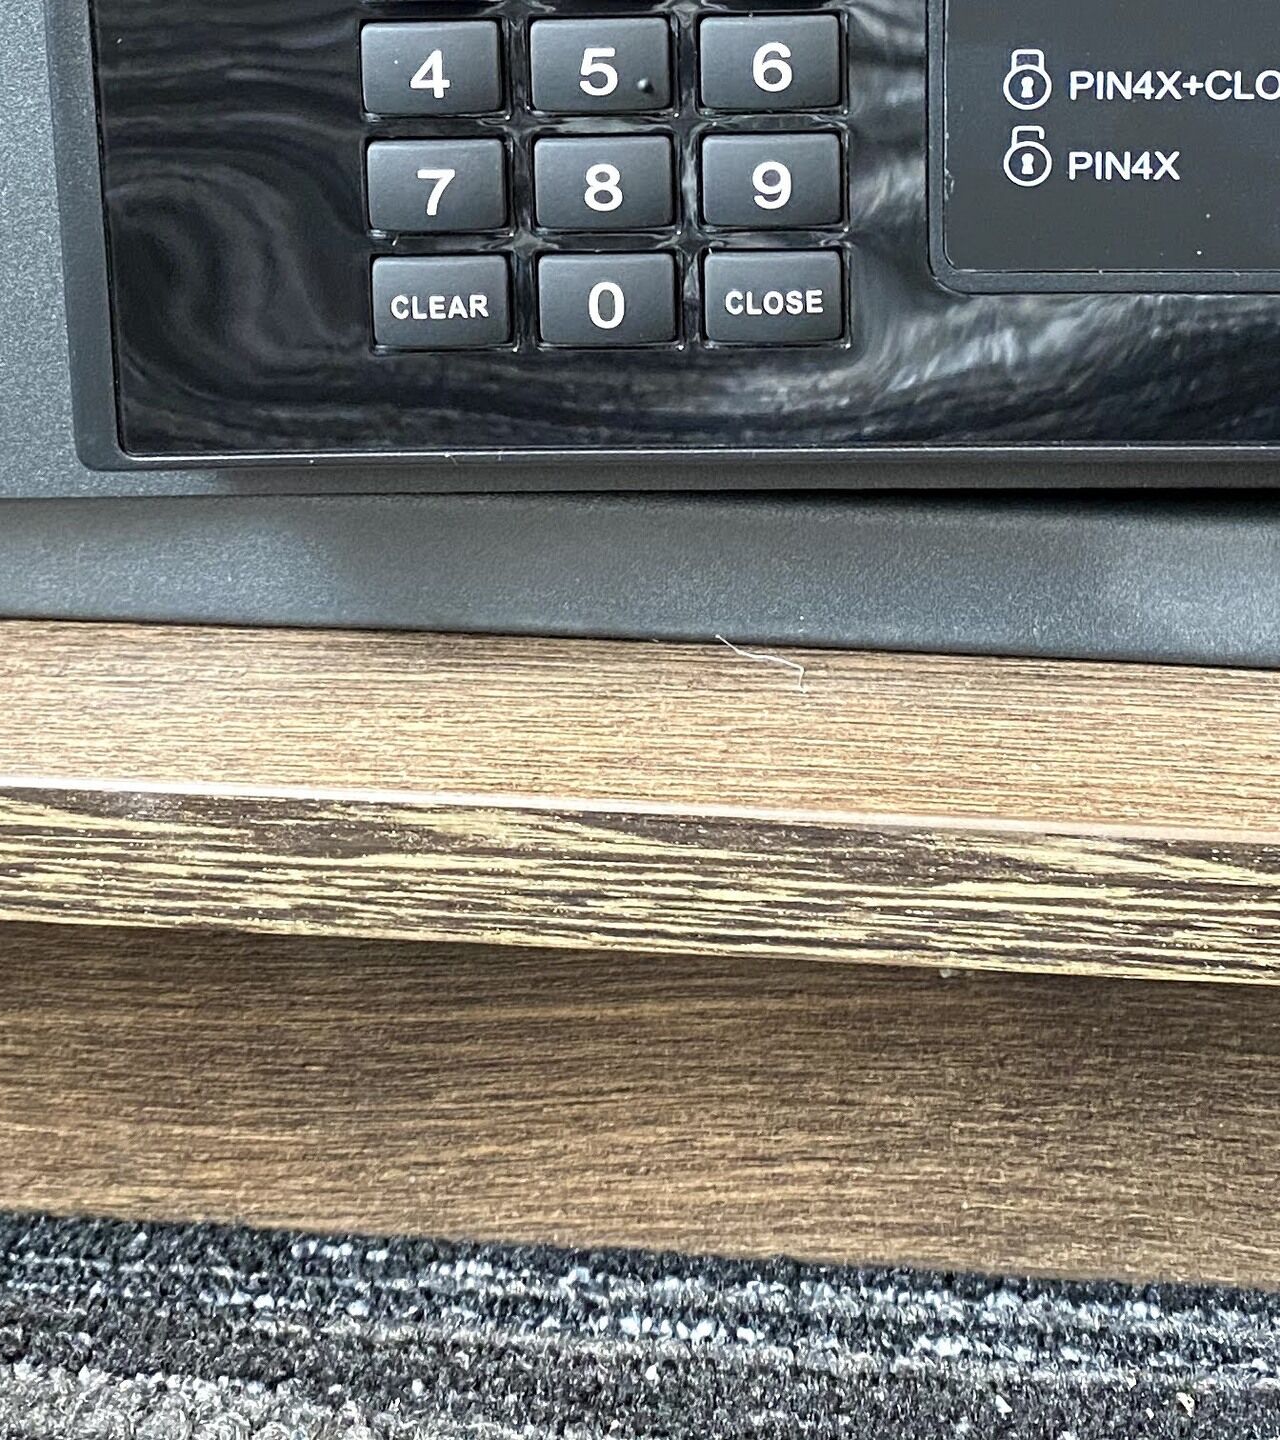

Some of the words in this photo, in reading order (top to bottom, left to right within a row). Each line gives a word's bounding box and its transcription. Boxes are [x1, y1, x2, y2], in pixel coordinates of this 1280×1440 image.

[410, 48, 451, 99] 4
[579, 46, 619, 96] 5
[752, 40, 793, 92] 6
[584, 162, 623, 212] 8
[751, 159, 792, 210] 9
[1068, 150, 1181, 181] PIN4X
[417, 166, 456, 216] 7
[390, 294, 489, 320] CLEAR
[588, 280, 625, 329] 0
[725, 288, 824, 315] CLOSE
